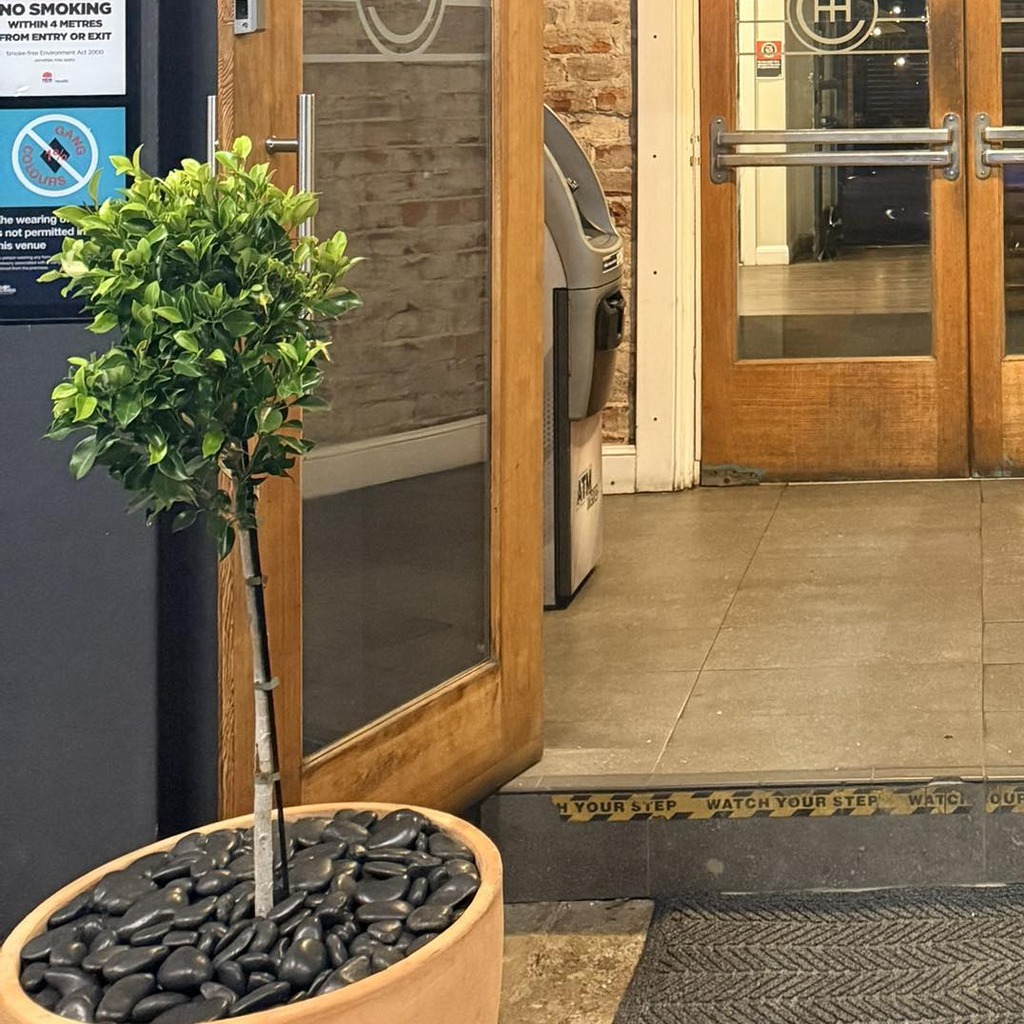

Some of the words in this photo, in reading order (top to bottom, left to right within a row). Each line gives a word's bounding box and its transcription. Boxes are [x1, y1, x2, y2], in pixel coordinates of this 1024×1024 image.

[0, 3, 25, 16] NO
[29, 2, 112, 16] SMOKING
[8, 20, 48, 29] WITHIN
[50, 20, 57, 28] 4
[60, 19, 103, 28] METRES
[0, 33, 29, 42] FROM
[32, 33, 68, 42] ENTRY
[70, 33, 85, 41] OR
[88, 32, 112, 41] EXIT
[54, 125, 86, 156] GANG
[22, 145, 67, 186] COLOURS
[0, 215, 14, 225] he
[15, 215, 57, 225] wearing
[5, 228, 23, 237] not
[24, 227, 75, 239] permitted
[15, 242, 47, 250] venue
[574, 801, 625, 813] YOUR
[631, 800, 677, 812] STEP
[706, 798, 770, 810] WATCH
[776, 796, 827, 808] YOUR
[832, 795, 879, 807] STEP
